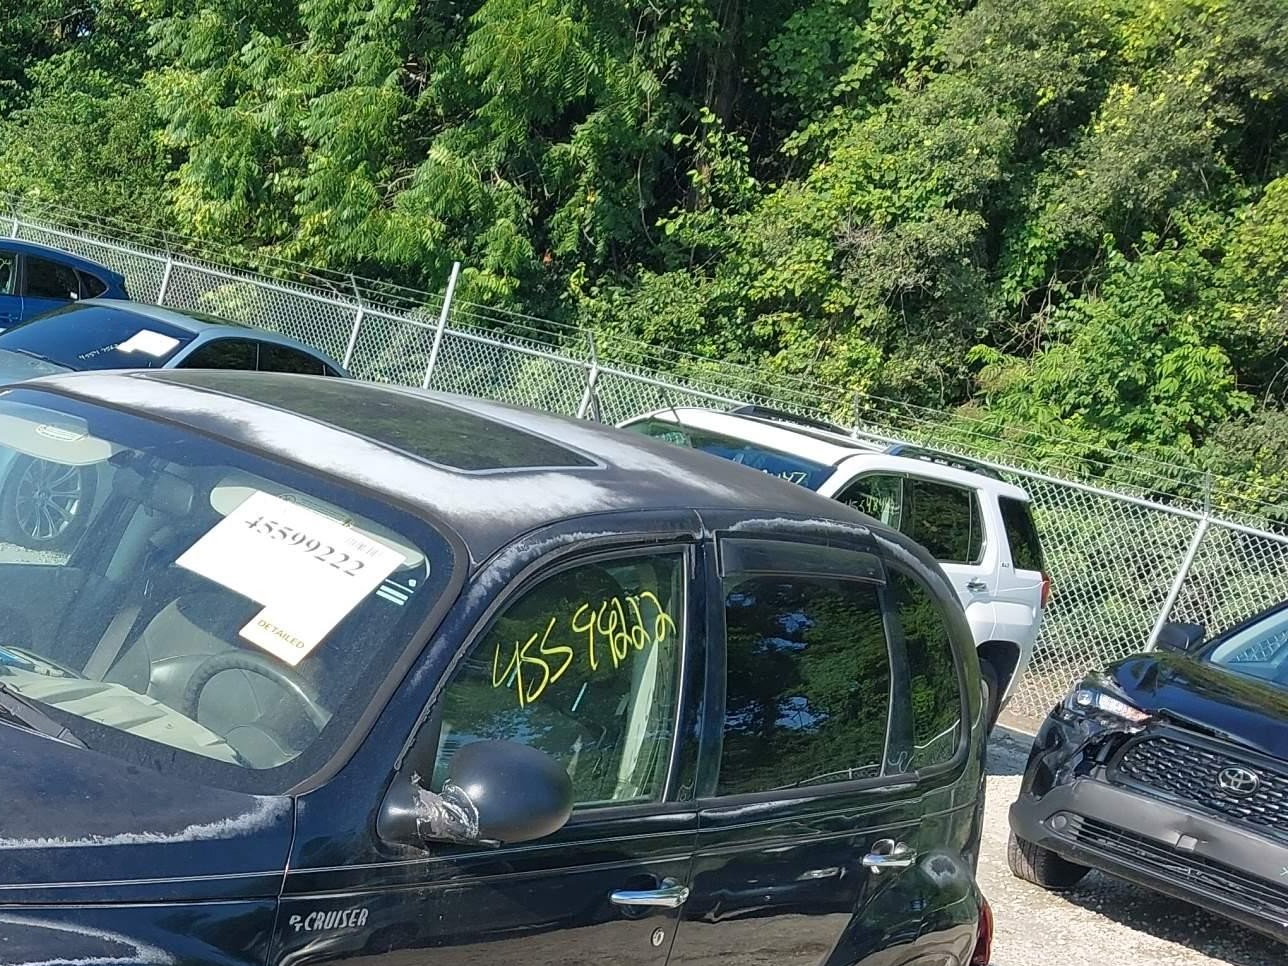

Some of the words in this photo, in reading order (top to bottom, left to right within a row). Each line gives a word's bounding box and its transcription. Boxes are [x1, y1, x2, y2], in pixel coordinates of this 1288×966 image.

[245, 516, 365, 577] 45599222
[257, 619, 305, 649] DETAILED
[492, 591, 677, 709] 45599222
[304, 908, 369, 931] CRUISER
